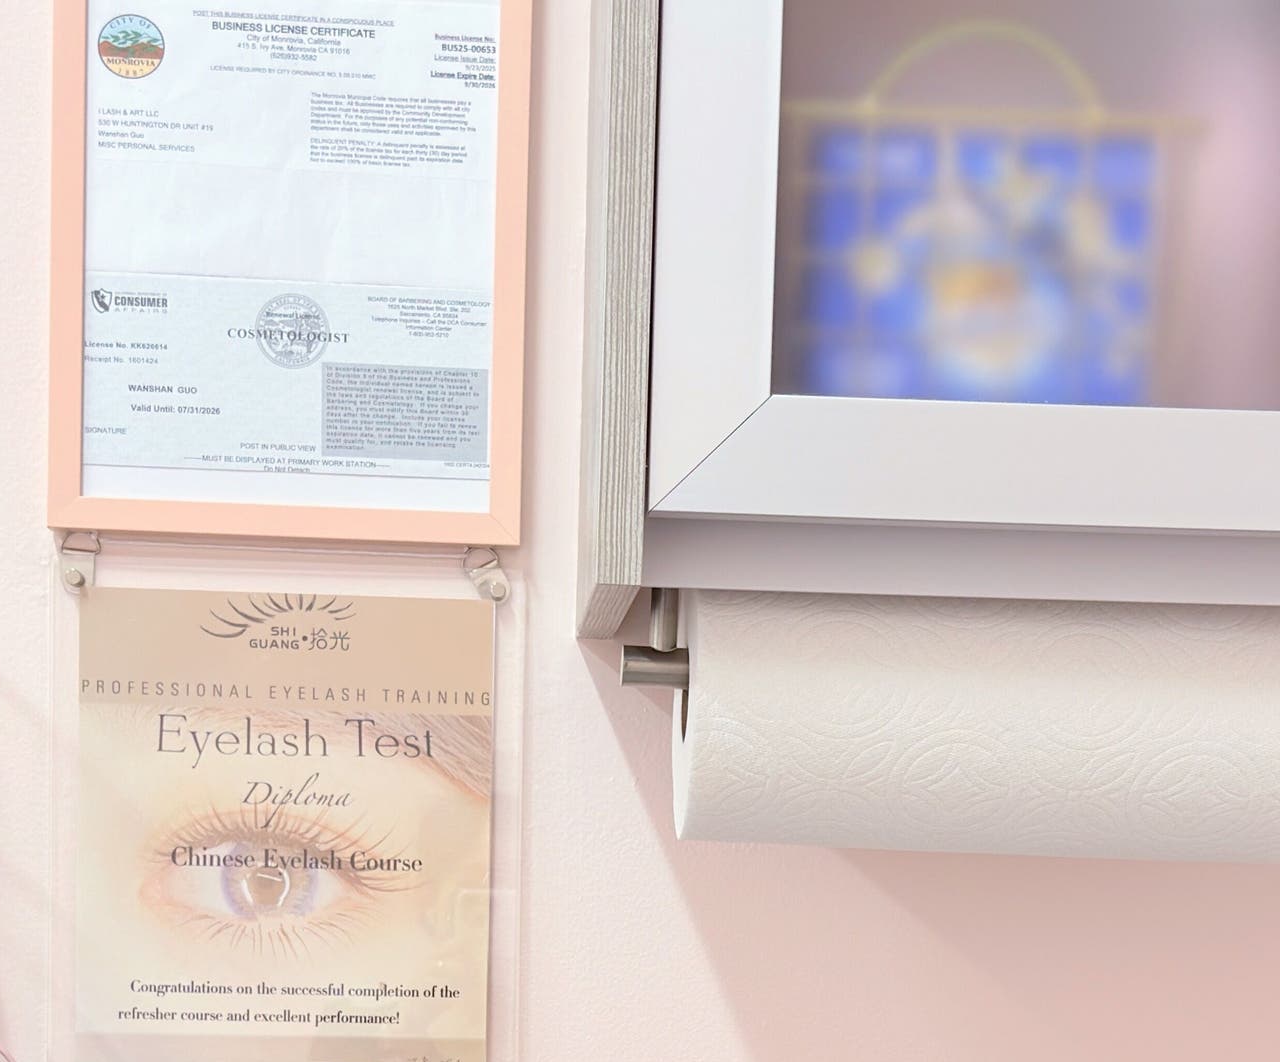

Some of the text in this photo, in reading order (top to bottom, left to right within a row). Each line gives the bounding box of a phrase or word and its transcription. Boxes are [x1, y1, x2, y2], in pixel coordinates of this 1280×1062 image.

[109, 17, 152, 30] CITY OF
[212, 21, 376, 38] BUSINESS LICENSE CERTIFICATE
[247, 34, 260, 42] City
[308, 38, 341, 46] California
[442, 44, 496, 54] BUS25-00653
[106, 57, 156, 68] MONROVIA
[434, 54, 459, 62] License
[430, 70, 456, 78] License
[456, 72, 478, 80] Expire
[102, 108, 122, 116] LASH
[146, 110, 160, 118] LLC
[121, 120, 169, 129] HUNTINGTON
[98, 130, 128, 138] Wanshan
[118, 142, 156, 150] PERSONAL
[158, 144, 195, 152] SERVICES
[114, 296, 168, 308] CONSUMER
[227, 328, 350, 343] COSMETOLOGIST
[128, 384, 198, 394] WANSHAN GUO
[130, 404, 220, 415] Valid Until: 07/31/2026
[84, 426, 128, 434] SIGNATURE
[240, 442, 260, 450] POST
[270, 444, 296, 452] PUBLIC
[235, 456, 276, 464] DISPLAYED
[288, 458, 320, 466] PRIMARY
[322, 459, 344, 467] WORK
[345, 460, 376, 468] STATION
[271, 626, 296, 636] SHI
[250, 639, 300, 650] GUANG
[308, 627, 350, 652] 拾光
[81, 679, 491, 706] PROFESSIONAL EYELASH TRAINING
[156, 714, 434, 769] Eyelash Test
[242, 773, 354, 828] Diploma
[170, 845, 424, 877] Chinese Eyelash Course
[130, 980, 460, 1001] Congratulations on the successful completion of the
[118, 1007, 400, 1027] refresher course and excellent performance!
